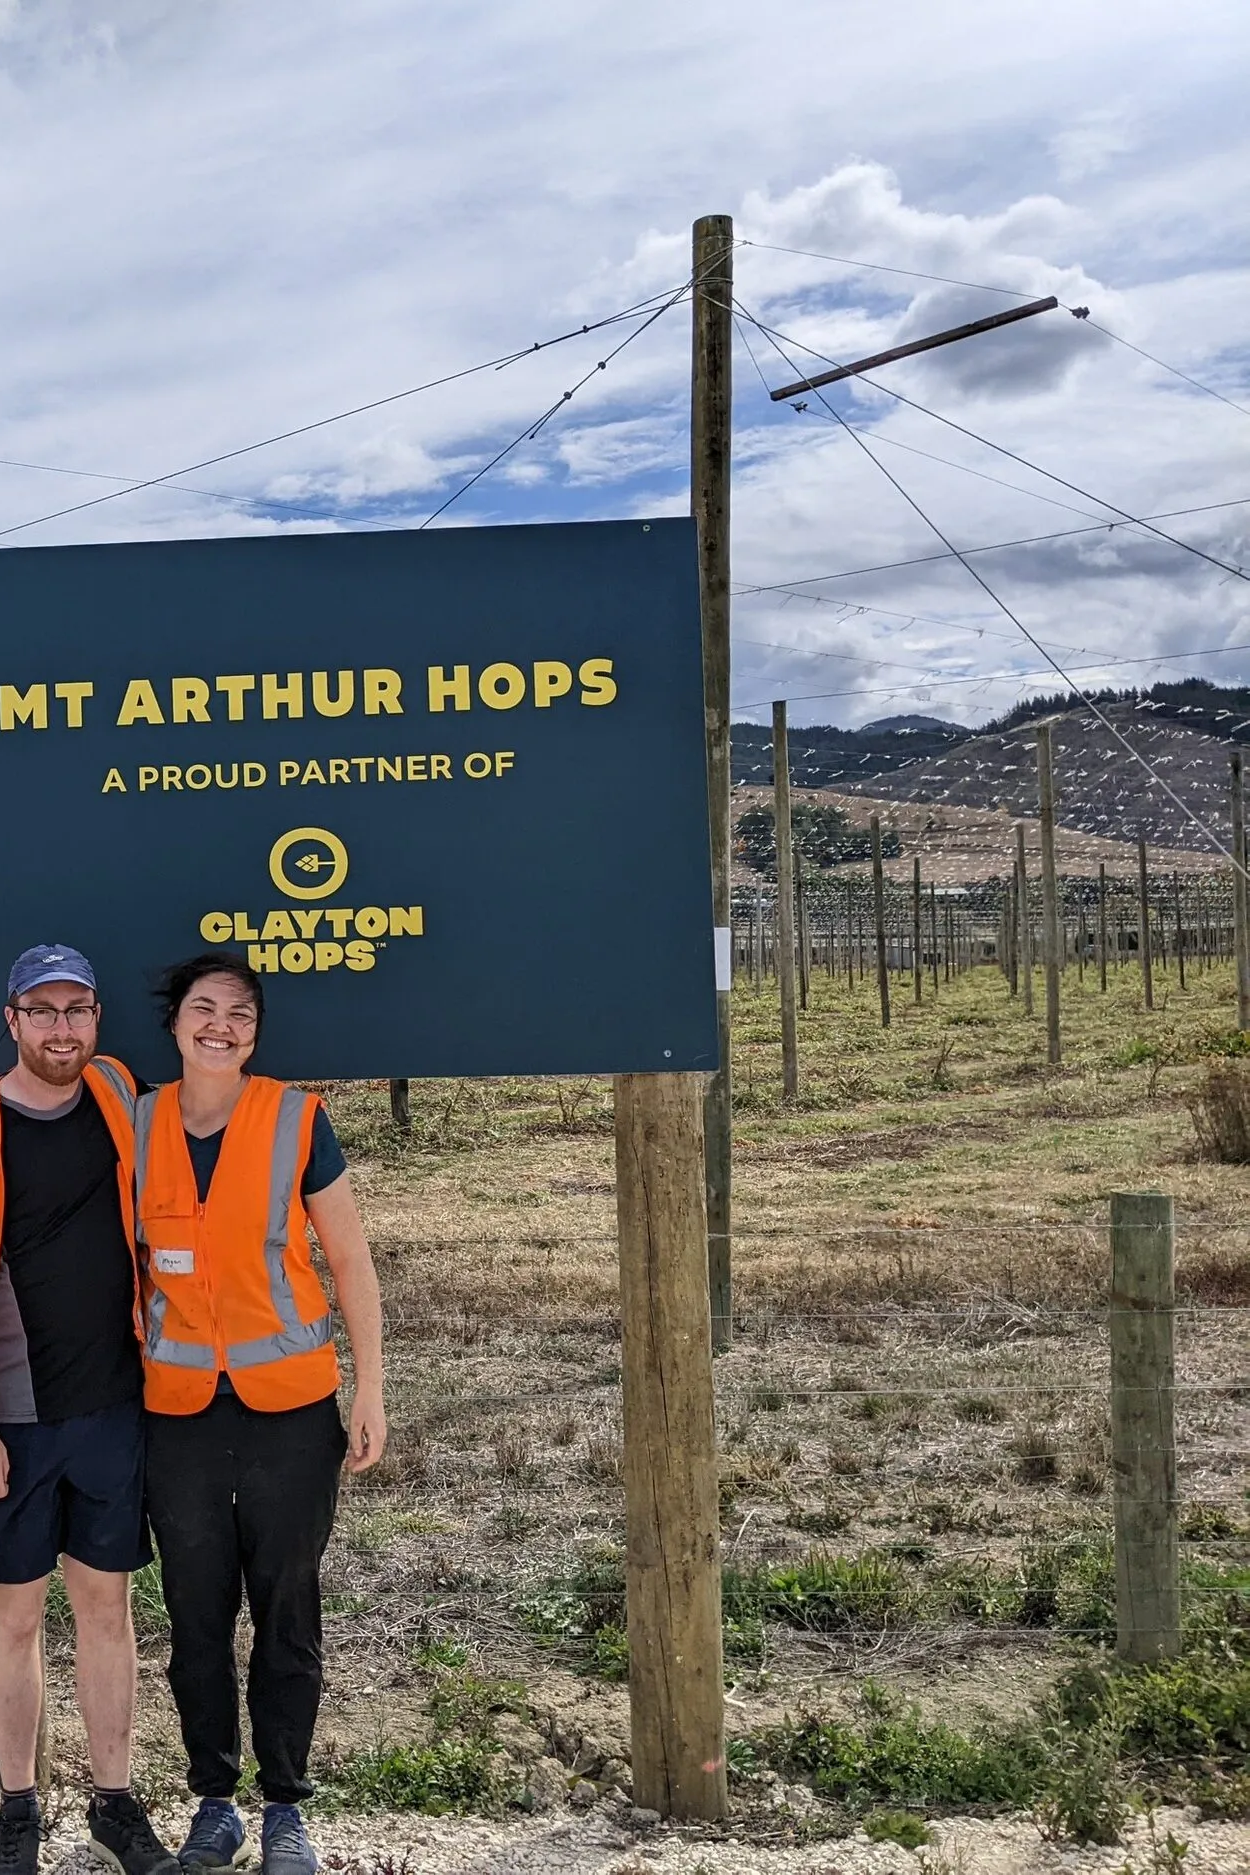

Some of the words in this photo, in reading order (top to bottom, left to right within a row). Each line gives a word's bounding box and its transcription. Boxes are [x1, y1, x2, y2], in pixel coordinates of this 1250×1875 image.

[0, 682, 94, 731] MT
[117, 668, 405, 727] ARTHUR
[428, 658, 618, 714] HOPS
[102, 768, 127, 793] A
[139, 763, 267, 791] PROUD
[280, 754, 452, 786] PARTNER
[464, 752, 516, 779] OF
[200, 906, 424, 943] CLAYTON
